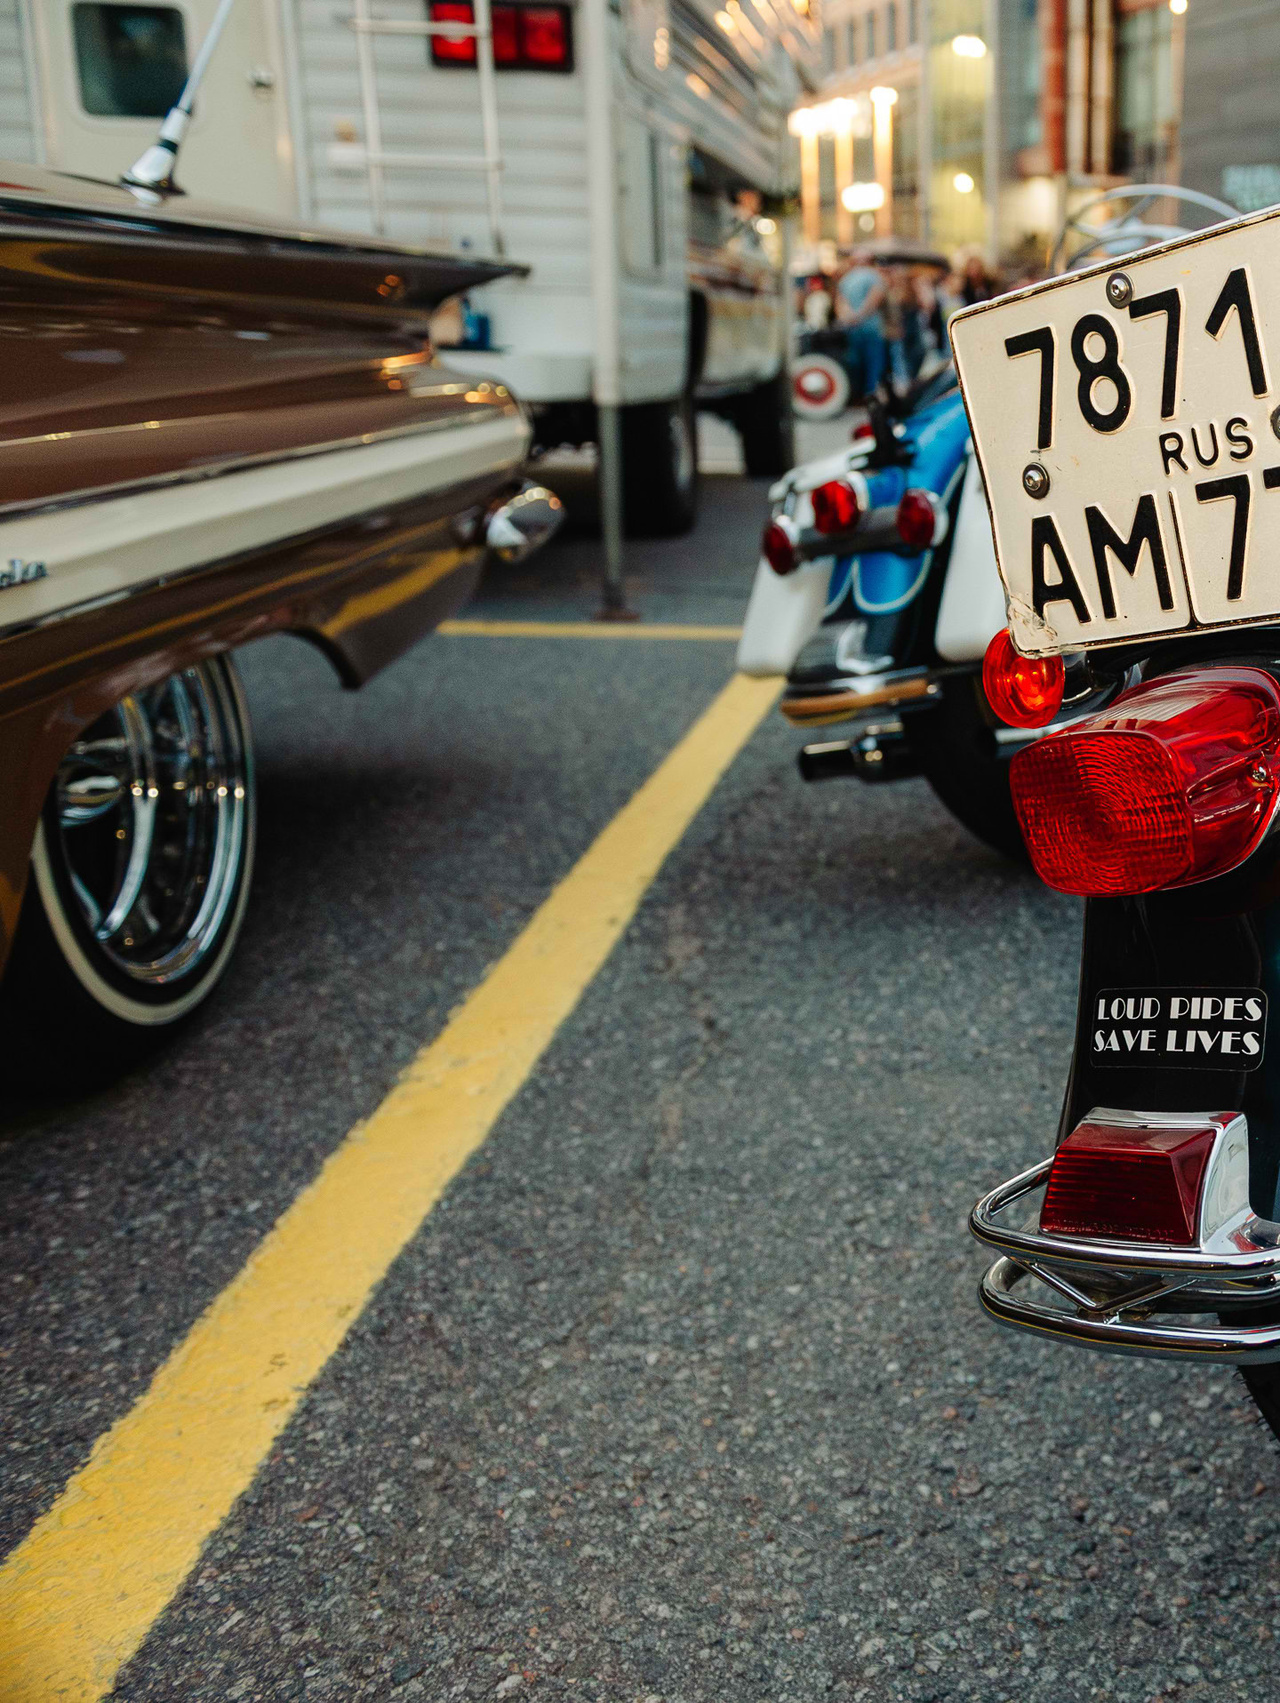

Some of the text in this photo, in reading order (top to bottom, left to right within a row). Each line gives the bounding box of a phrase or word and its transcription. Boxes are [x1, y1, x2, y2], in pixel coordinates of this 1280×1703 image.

[1004, 267, 1270, 451] 7871
[1158, 416, 1254, 475] RUS
[1031, 493, 1175, 624] AM
[1097, 997, 1262, 1022] LOUD PIPES
[1093, 1029, 1260, 1055] SAVE LIVES
